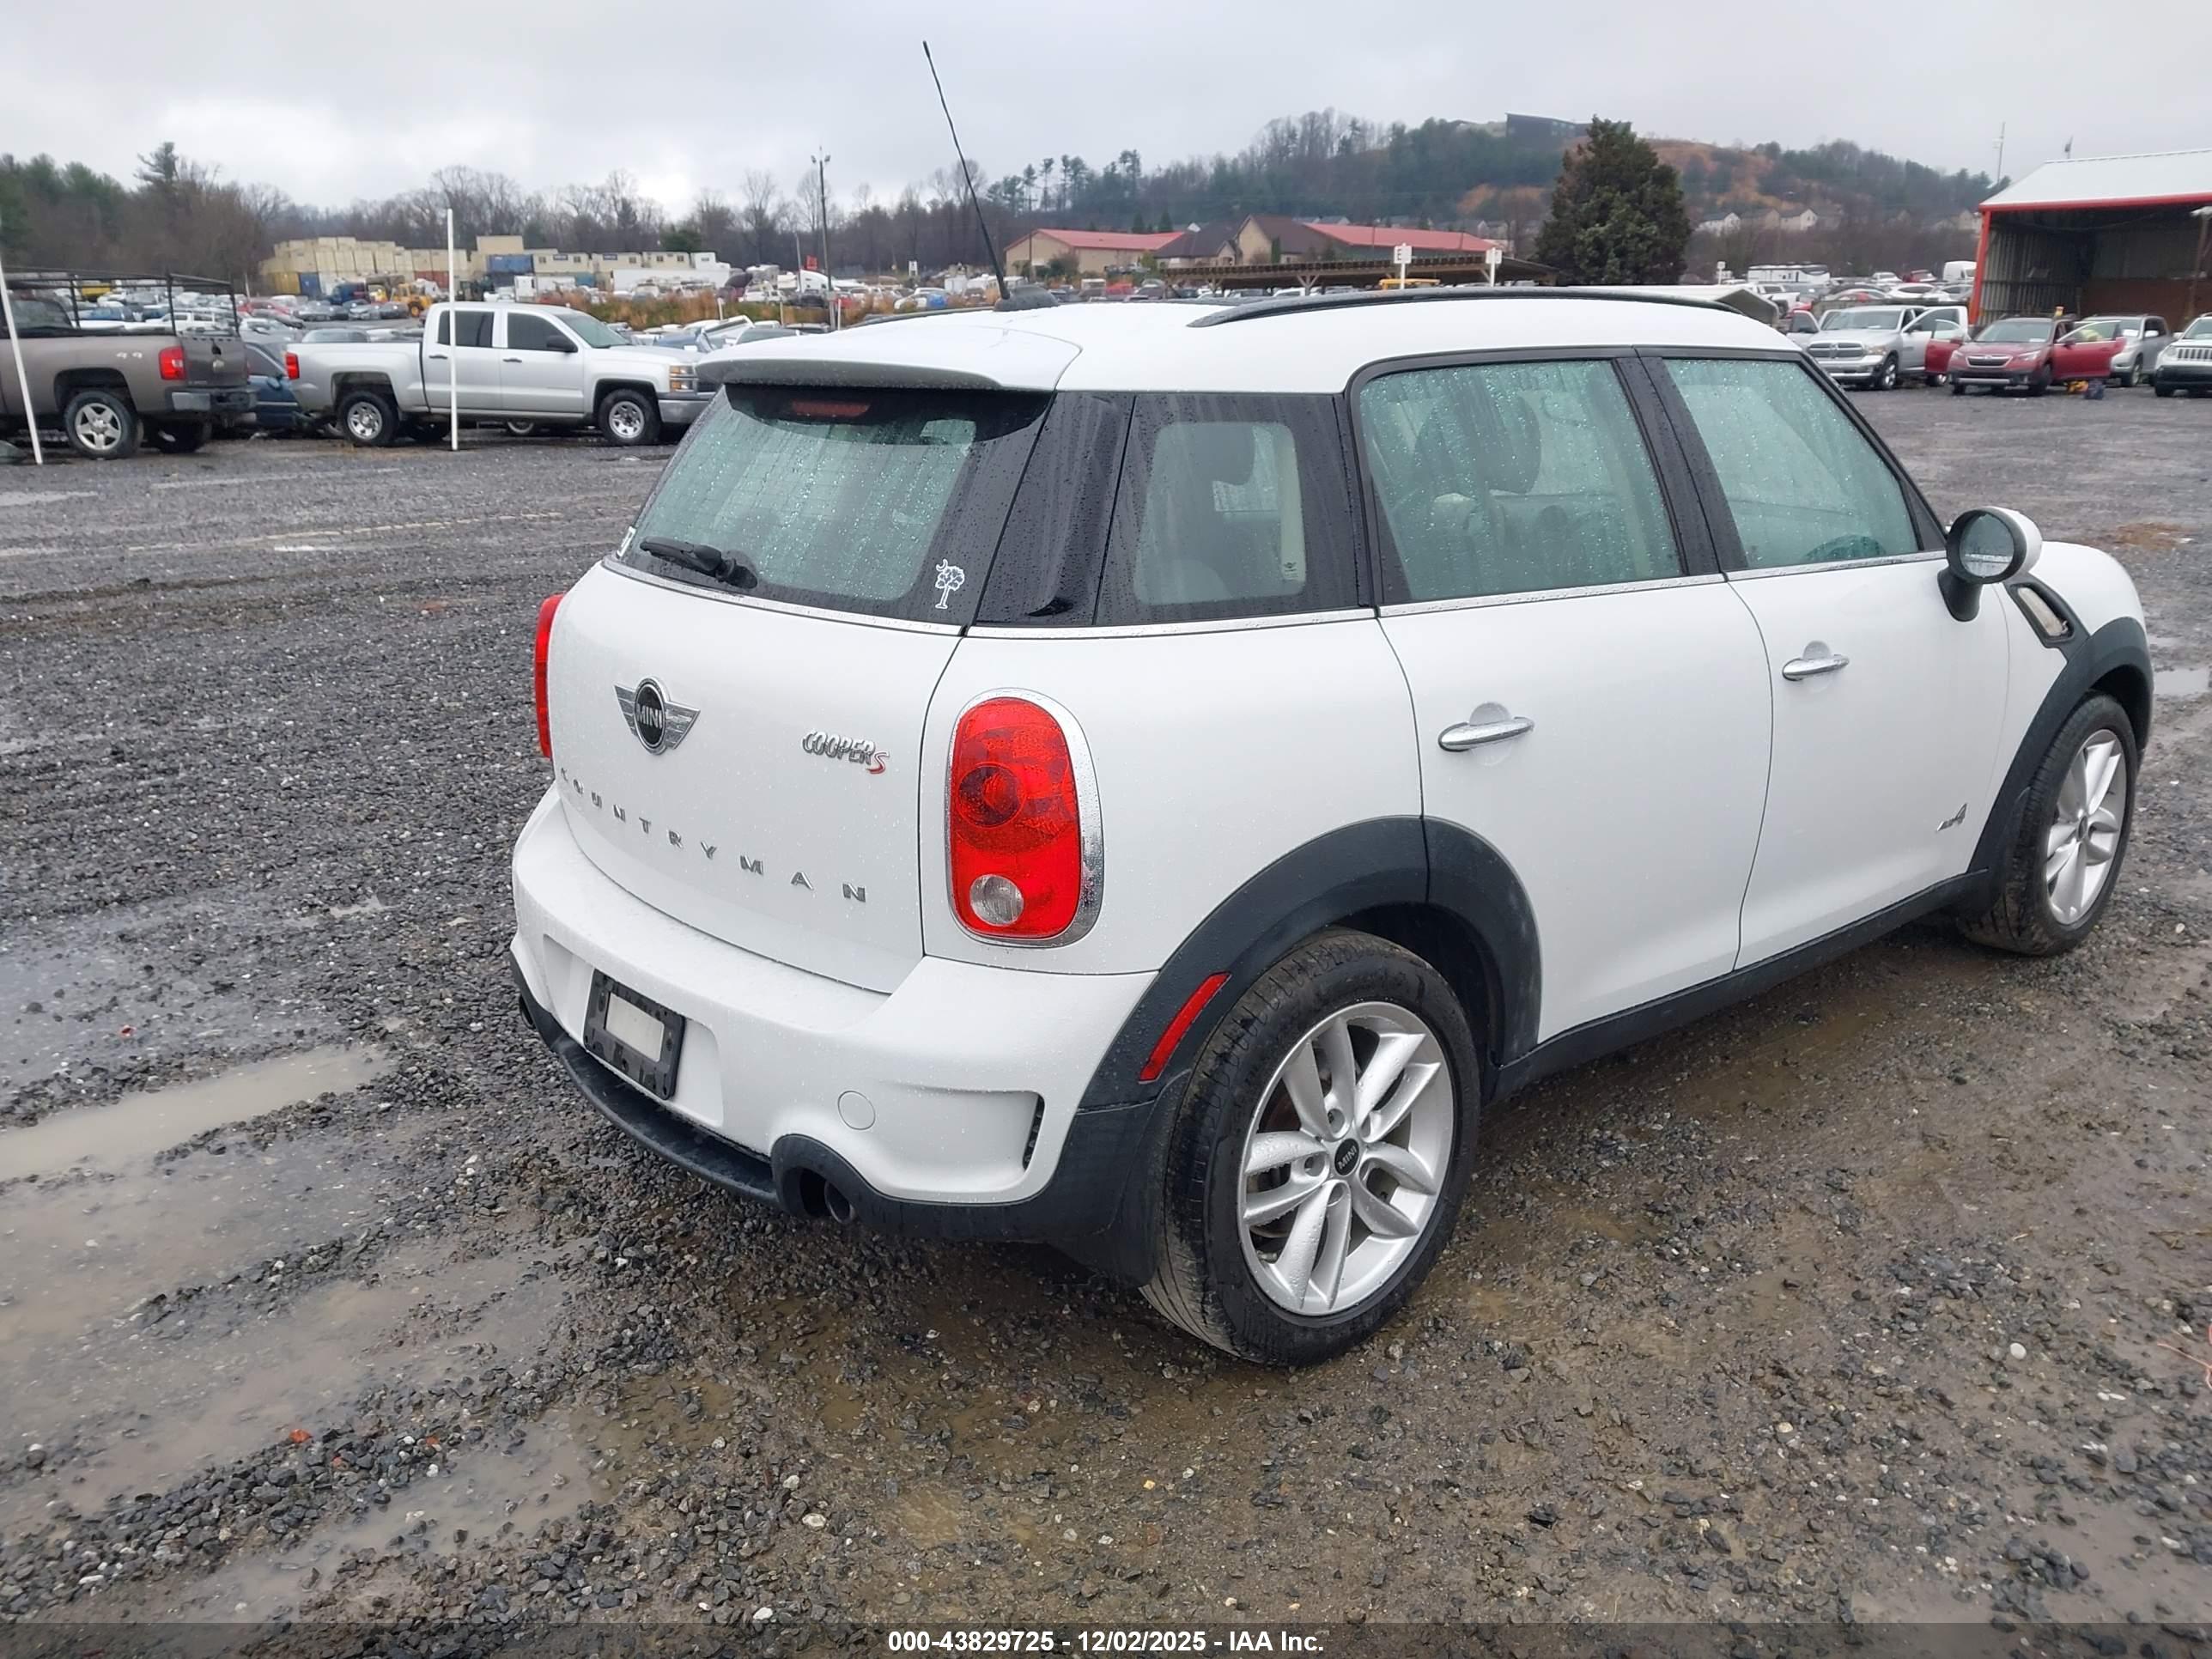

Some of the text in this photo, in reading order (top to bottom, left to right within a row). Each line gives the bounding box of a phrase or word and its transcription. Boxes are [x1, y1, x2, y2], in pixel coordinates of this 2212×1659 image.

[636, 703, 663, 730] MINI
[802, 731, 876, 765] COOPER
[560, 767, 867, 903] COUNTRYMAN
[1338, 1146, 1357, 1170] MINI
